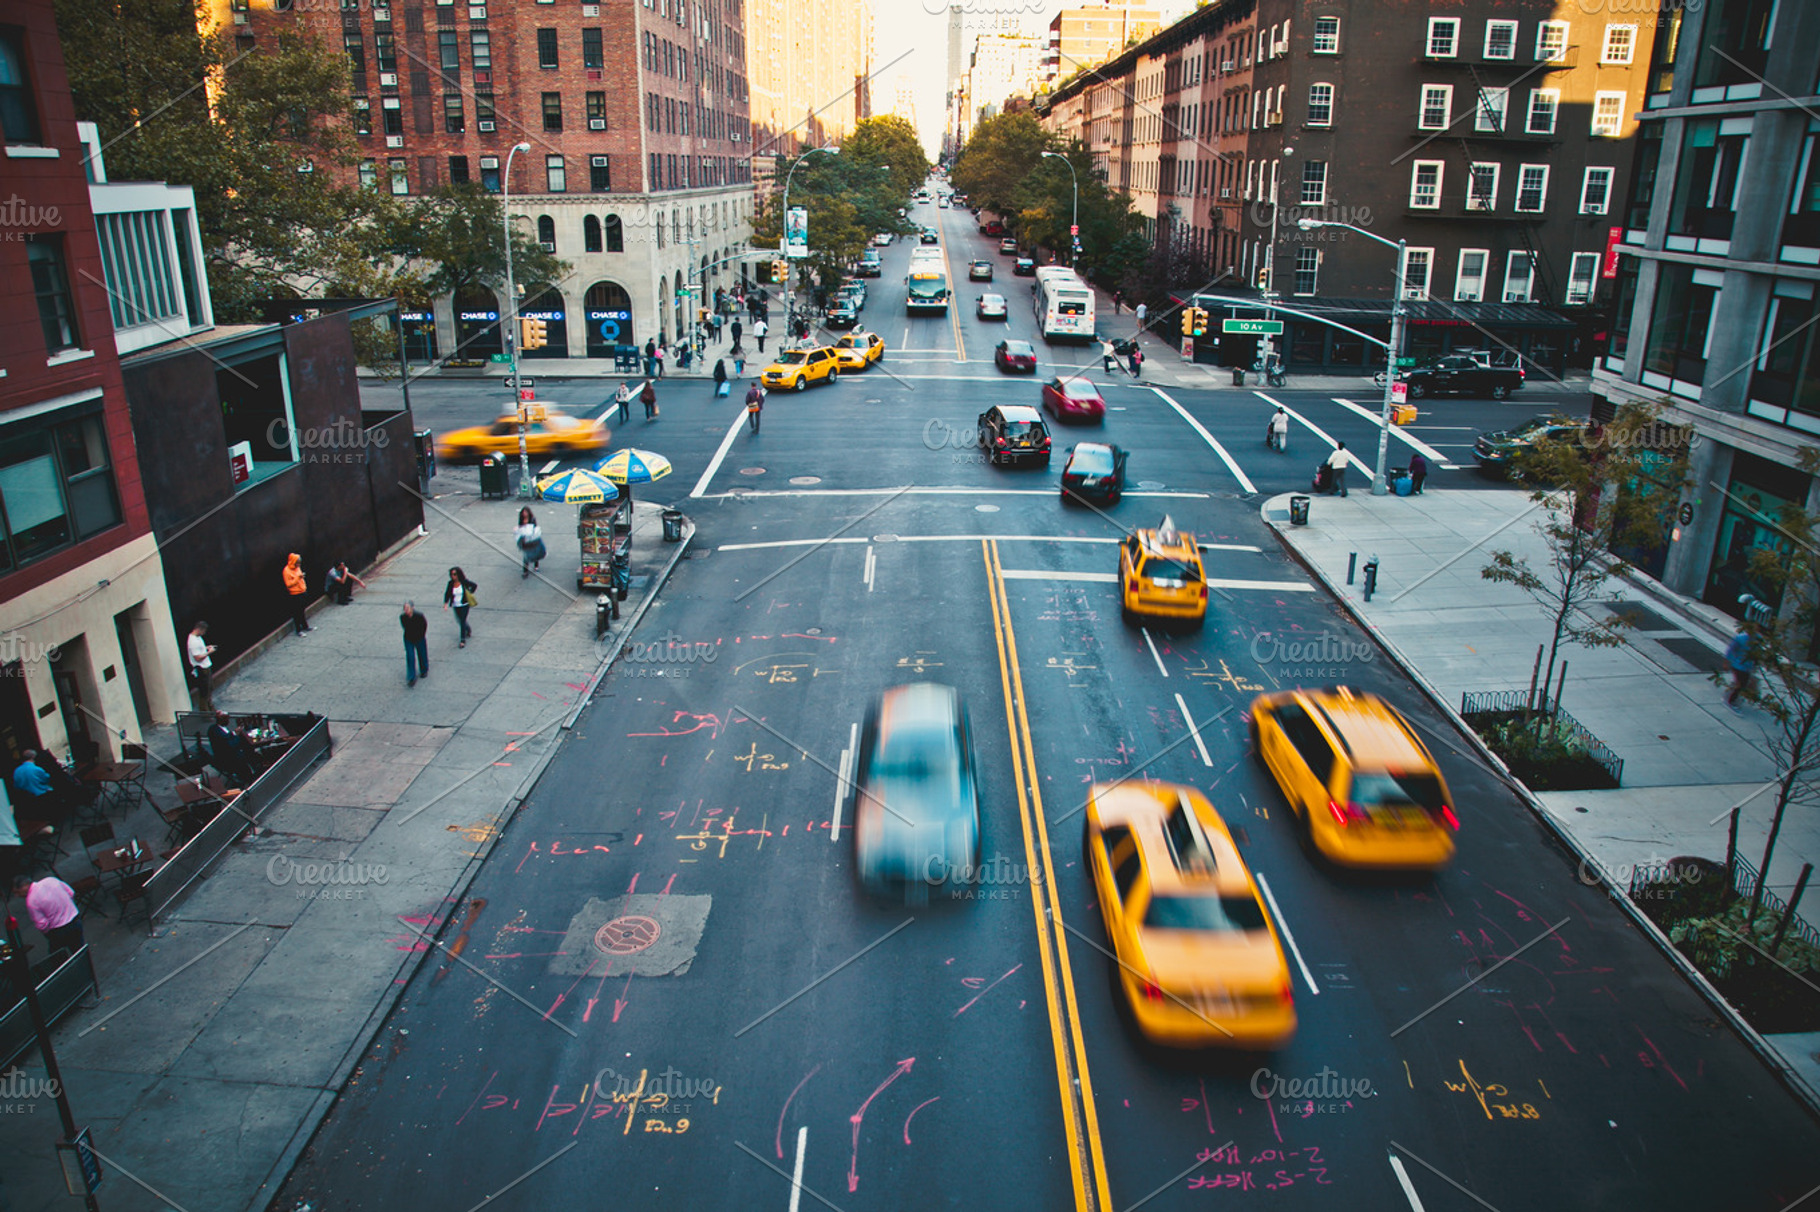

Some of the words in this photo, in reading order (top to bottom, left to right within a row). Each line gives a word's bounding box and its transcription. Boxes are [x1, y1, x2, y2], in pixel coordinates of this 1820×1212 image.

[461, 312, 487, 320] CHASE
[525, 312, 553, 320] CHASE
[591, 311, 619, 319] CHASE
[568, 494, 602, 502] SABRETT
